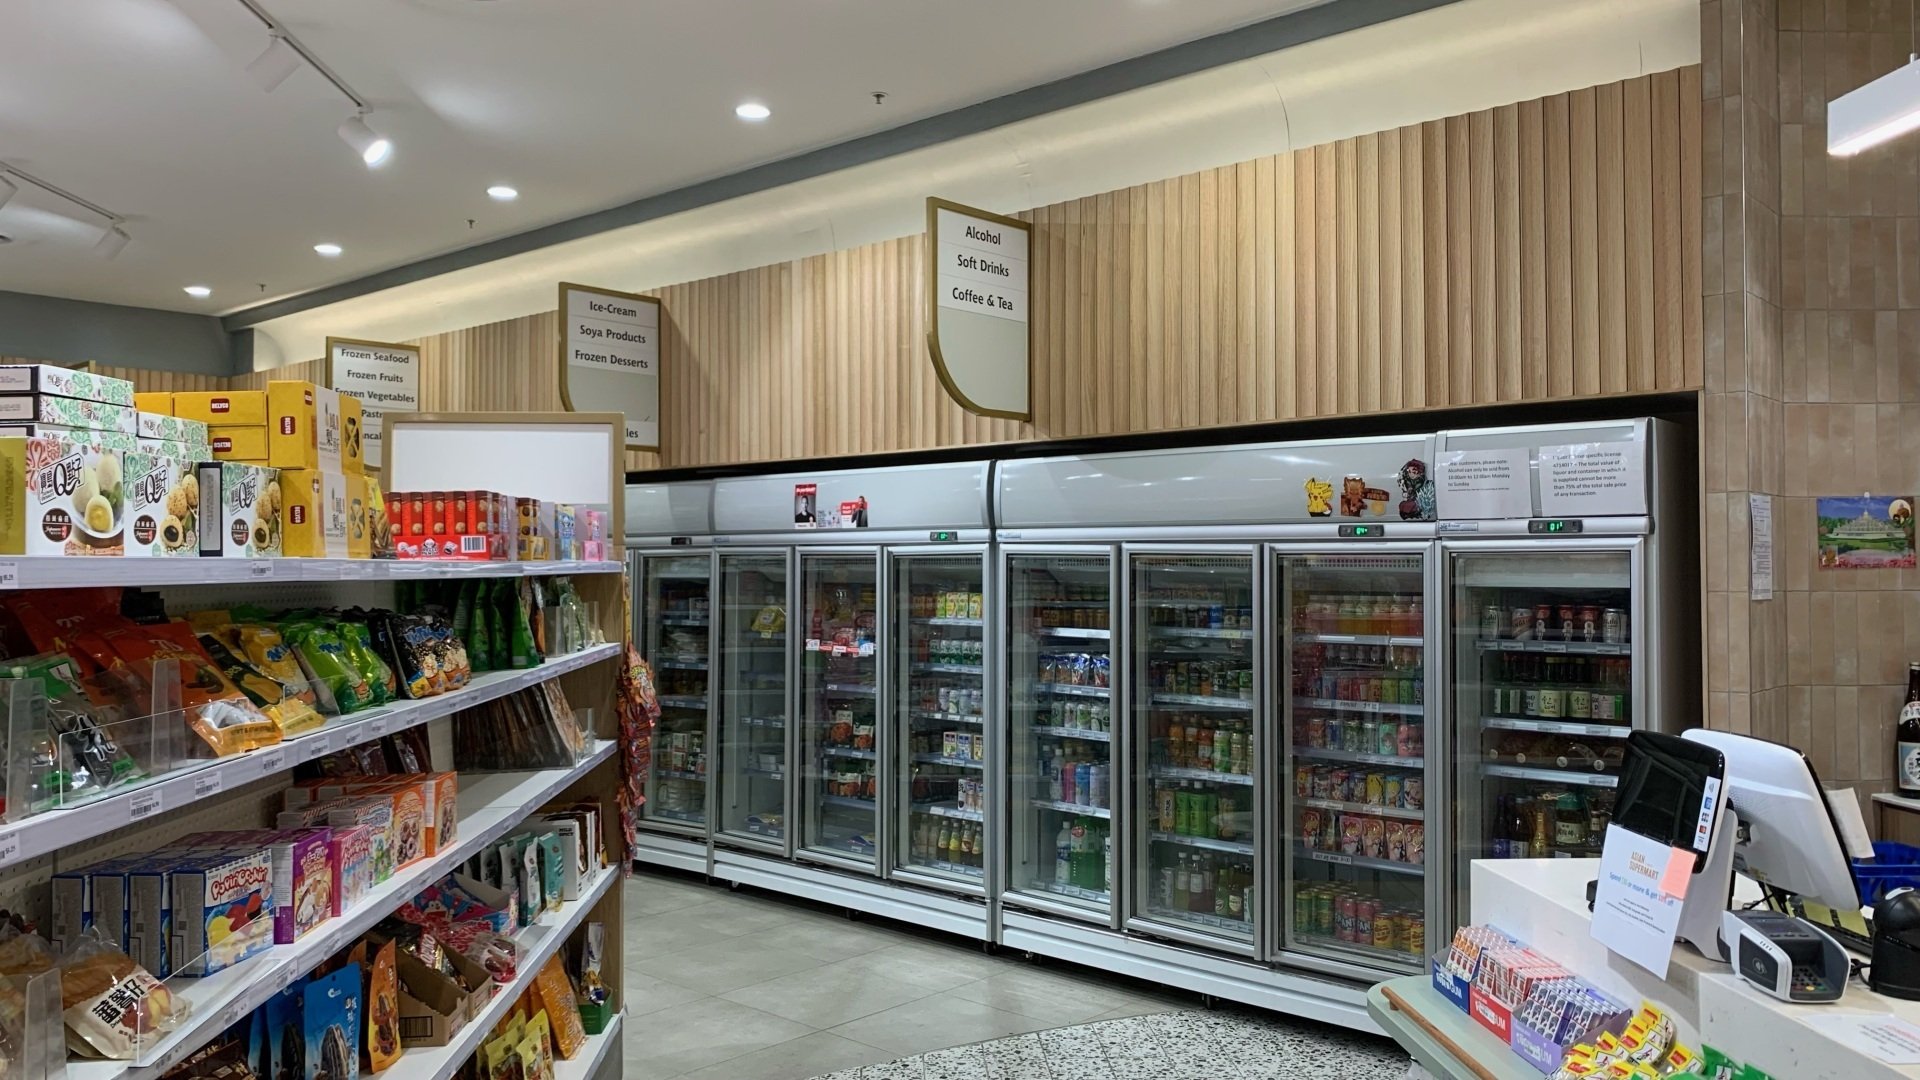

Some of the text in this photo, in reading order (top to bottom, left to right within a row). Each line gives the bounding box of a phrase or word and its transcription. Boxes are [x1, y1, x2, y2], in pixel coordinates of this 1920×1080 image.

[965, 225, 1001, 245] Alcohol
[957, 254, 1009, 277] Soft Drinks
[589, 301, 637, 317] Ice-Cream
[952, 287, 1014, 311] Coffee & Tea
[580, 324, 647, 344] Soya Products
[341, 348, 409, 364] Frozen Seafood
[575, 349, 649, 369] Frozen Desserts
[347, 369, 404, 383] Frozen Fruits
[367, 390, 415, 403] Vegetables
[361, 409, 383, 419] Pastr
[1629, 861, 1659, 881] SUPERMART
